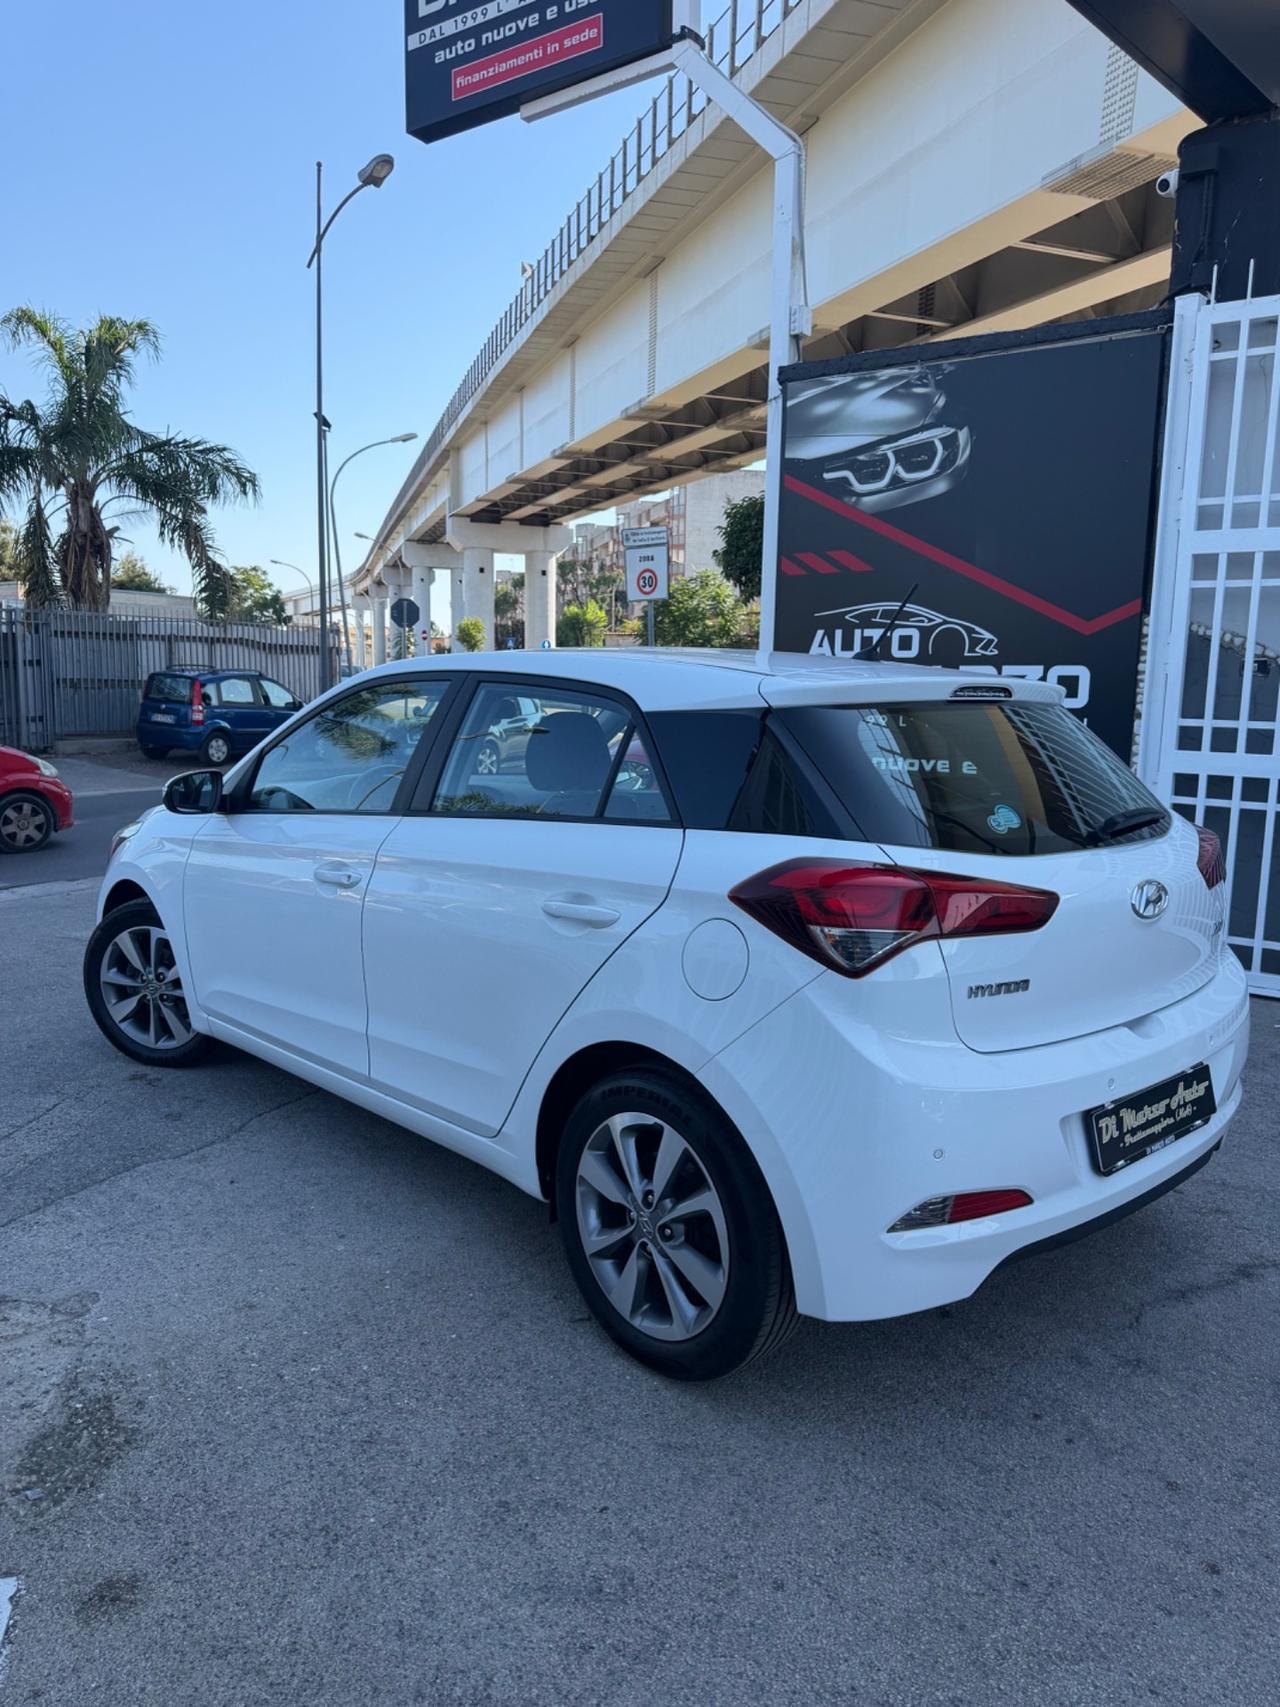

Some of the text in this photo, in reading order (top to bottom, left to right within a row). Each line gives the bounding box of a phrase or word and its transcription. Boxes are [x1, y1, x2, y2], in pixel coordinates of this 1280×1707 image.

[418, 24, 446, 45] DAL
[453, 7, 489, 31] 1999
[434, 37, 476, 64] auto
[481, 14, 539, 47] nuove
[546, 4, 558, 20] e
[456, 27, 598, 89] finanziamenti in sede
[641, 575, 654, 589] 30
[808, 627, 920, 659] AUTO
[967, 978, 1031, 1000] HYUNDAI
[1098, 1114, 1120, 1145] Di
[1170, 1080, 1209, 1110] Auto
